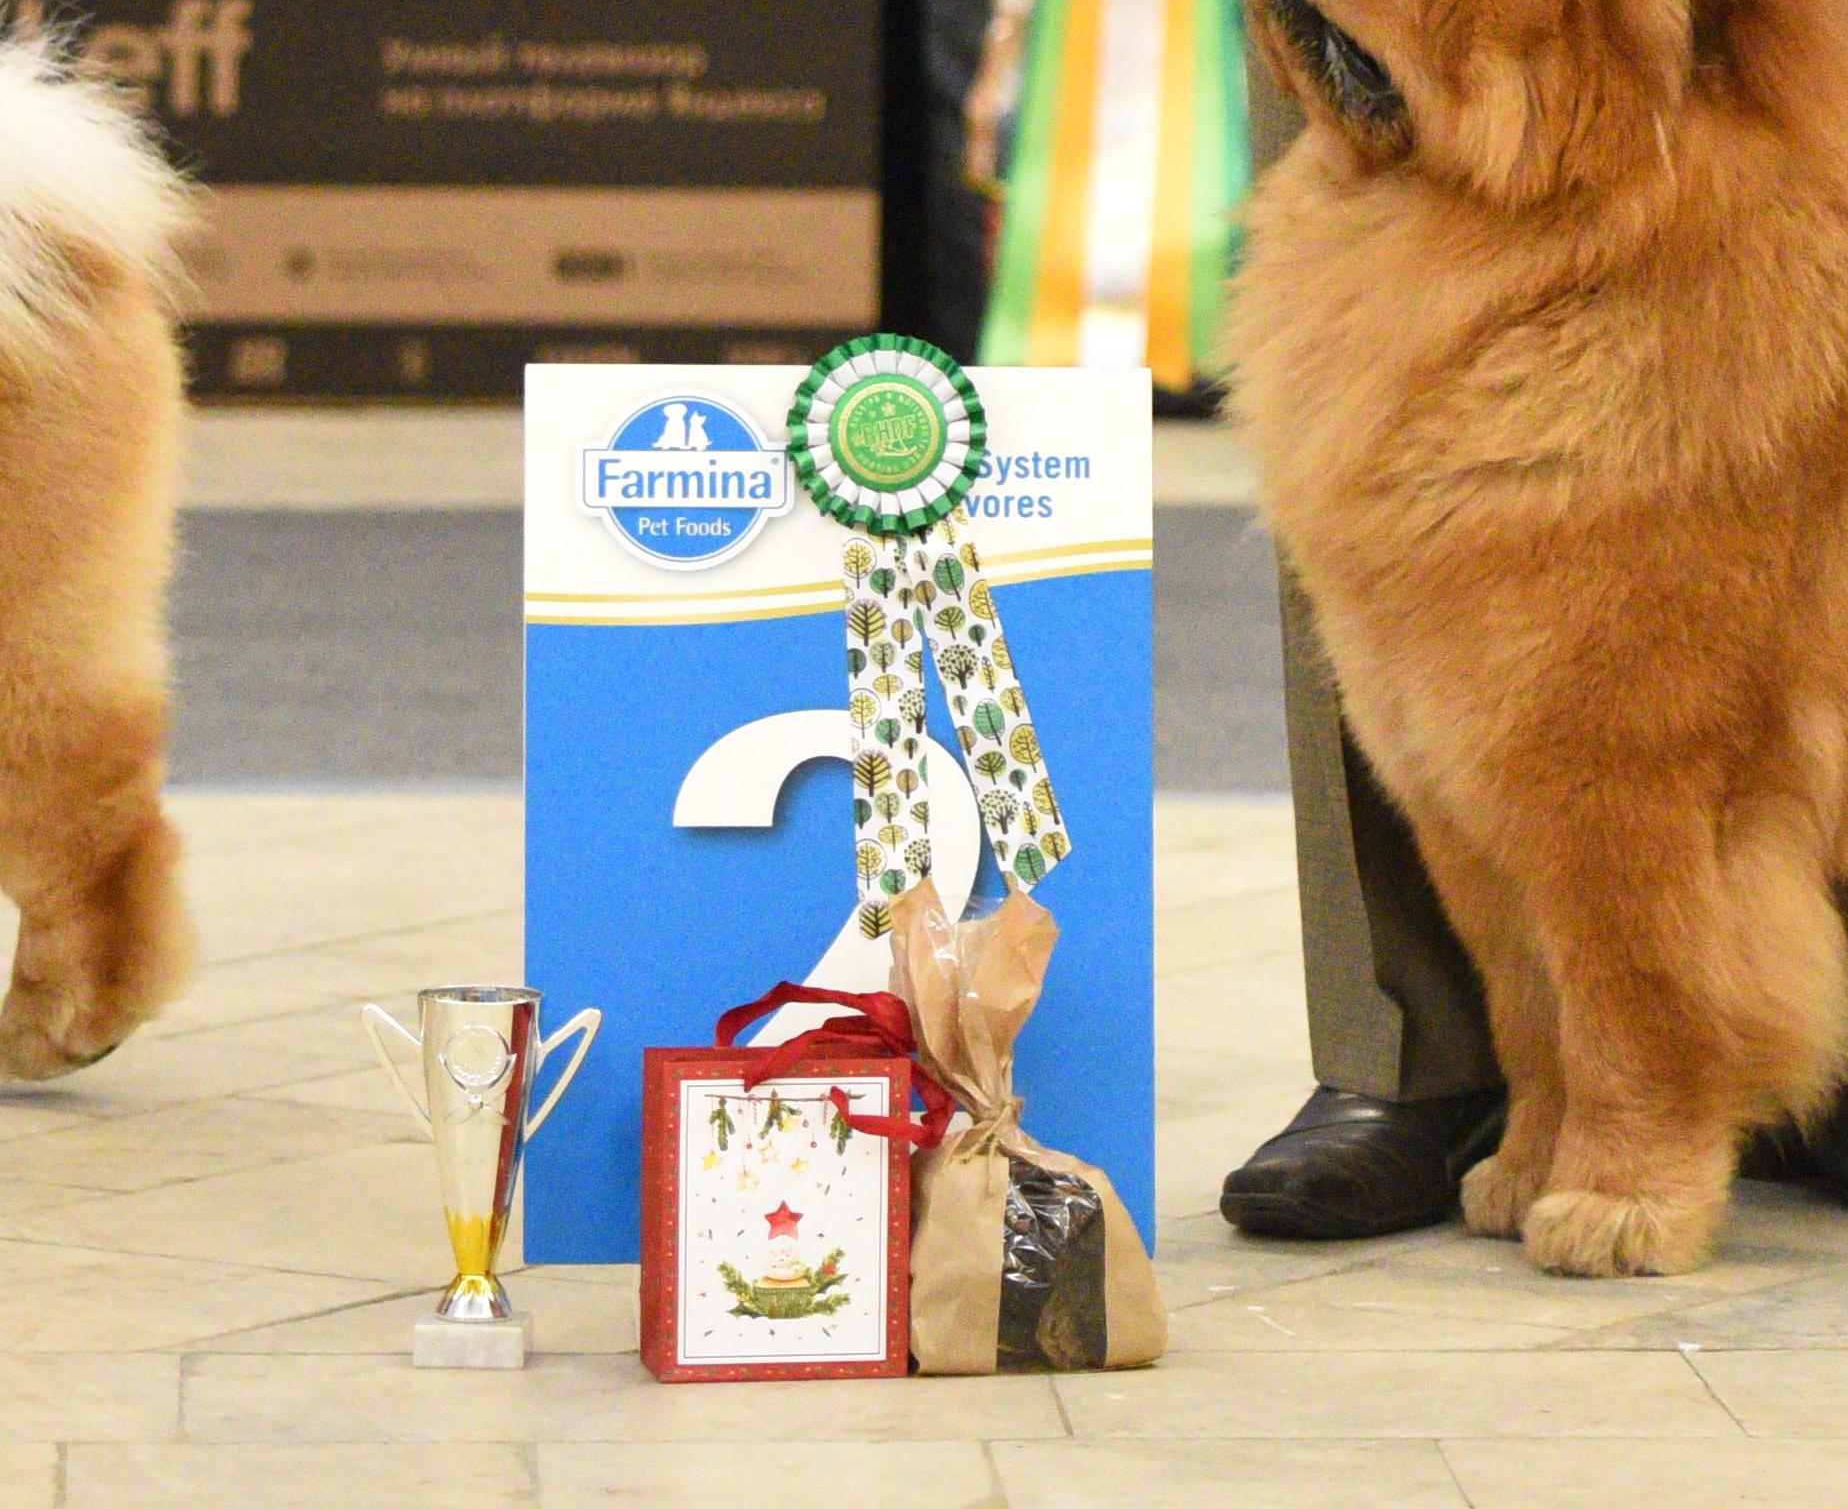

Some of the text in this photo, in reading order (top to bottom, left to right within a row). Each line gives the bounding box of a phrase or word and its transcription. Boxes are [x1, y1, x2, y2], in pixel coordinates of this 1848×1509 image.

[597, 458, 773, 500] Farmina
[977, 449, 1091, 486] System
[964, 493, 1054, 519] vores
[638, 516, 732, 537] Pet Foods
